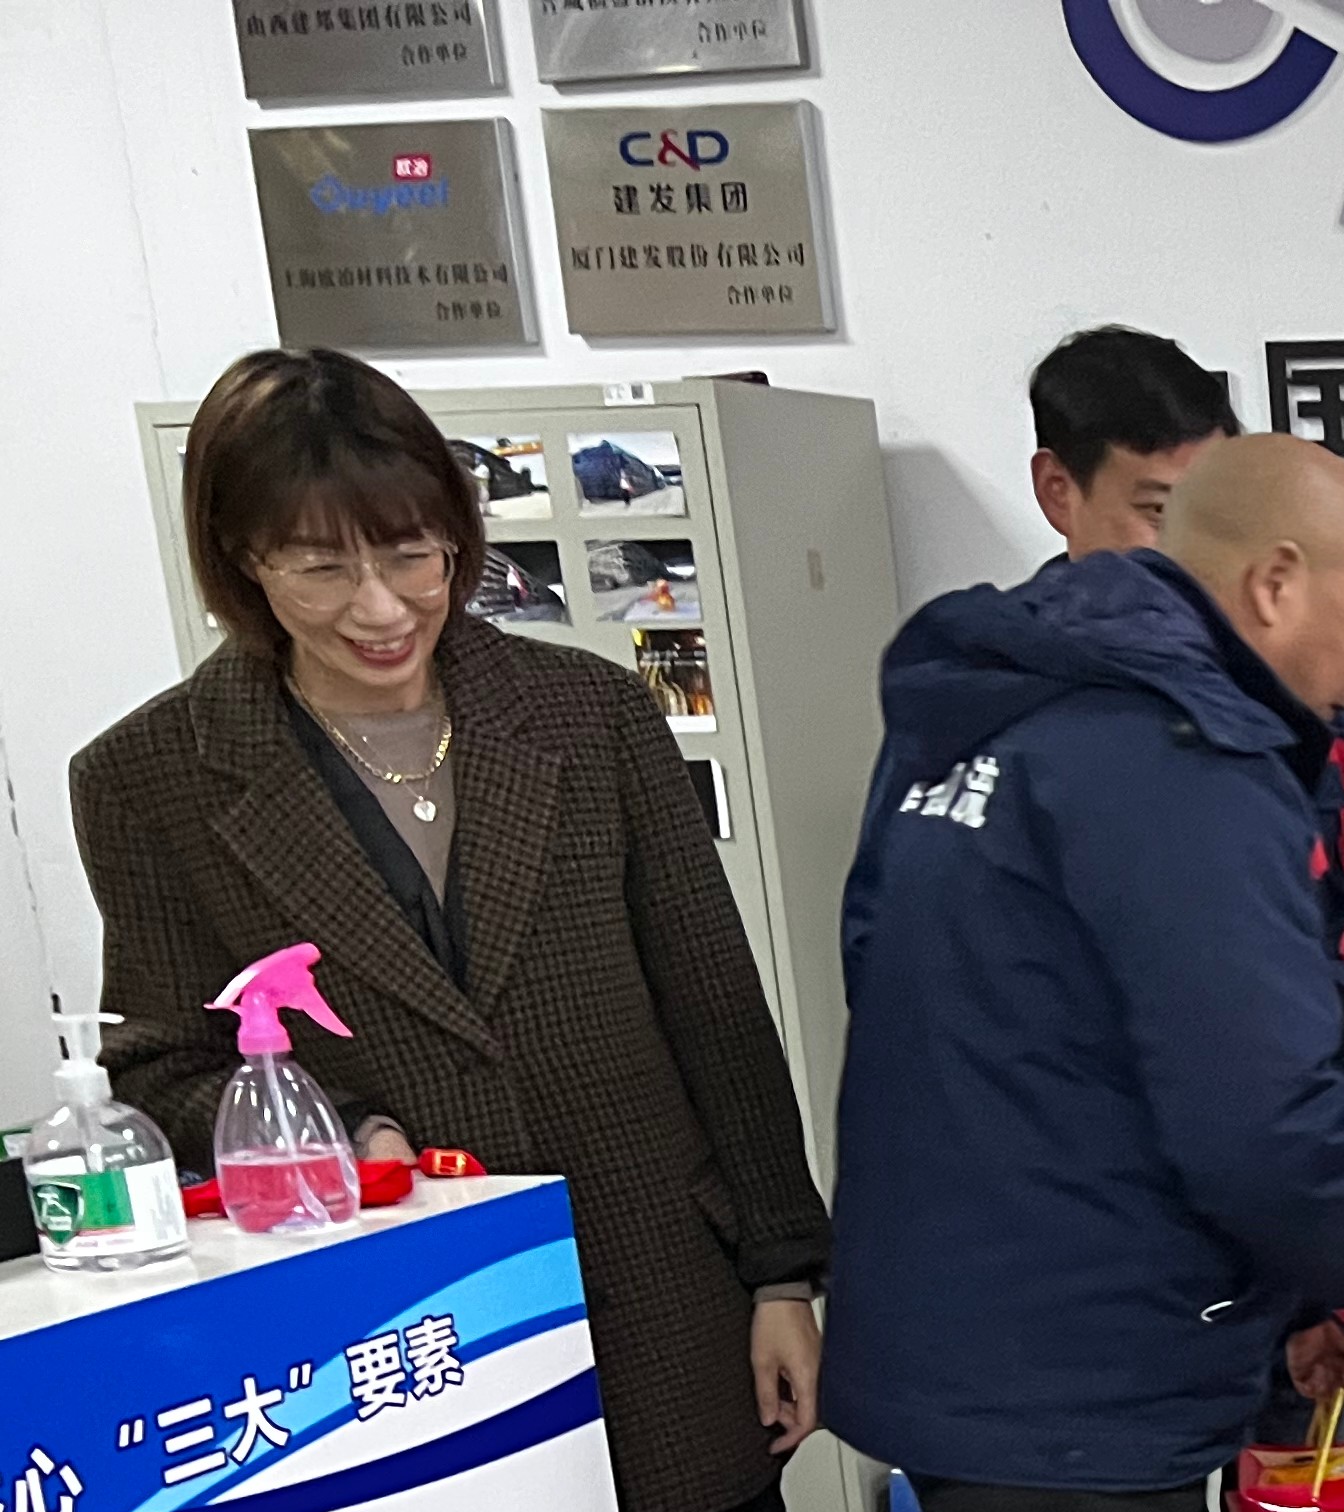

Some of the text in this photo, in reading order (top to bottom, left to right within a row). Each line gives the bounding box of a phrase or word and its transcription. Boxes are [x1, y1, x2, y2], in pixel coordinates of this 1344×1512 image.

[697, 19, 767, 43] 合作单位
[618, 128, 730, 172] C&D
[612, 181, 749, 216] 建发集团
[571, 242, 805, 271] 厦门建发股份有限公司
[727, 284, 795, 306] 合作单位
[436, 301, 503, 321] 合作单位
